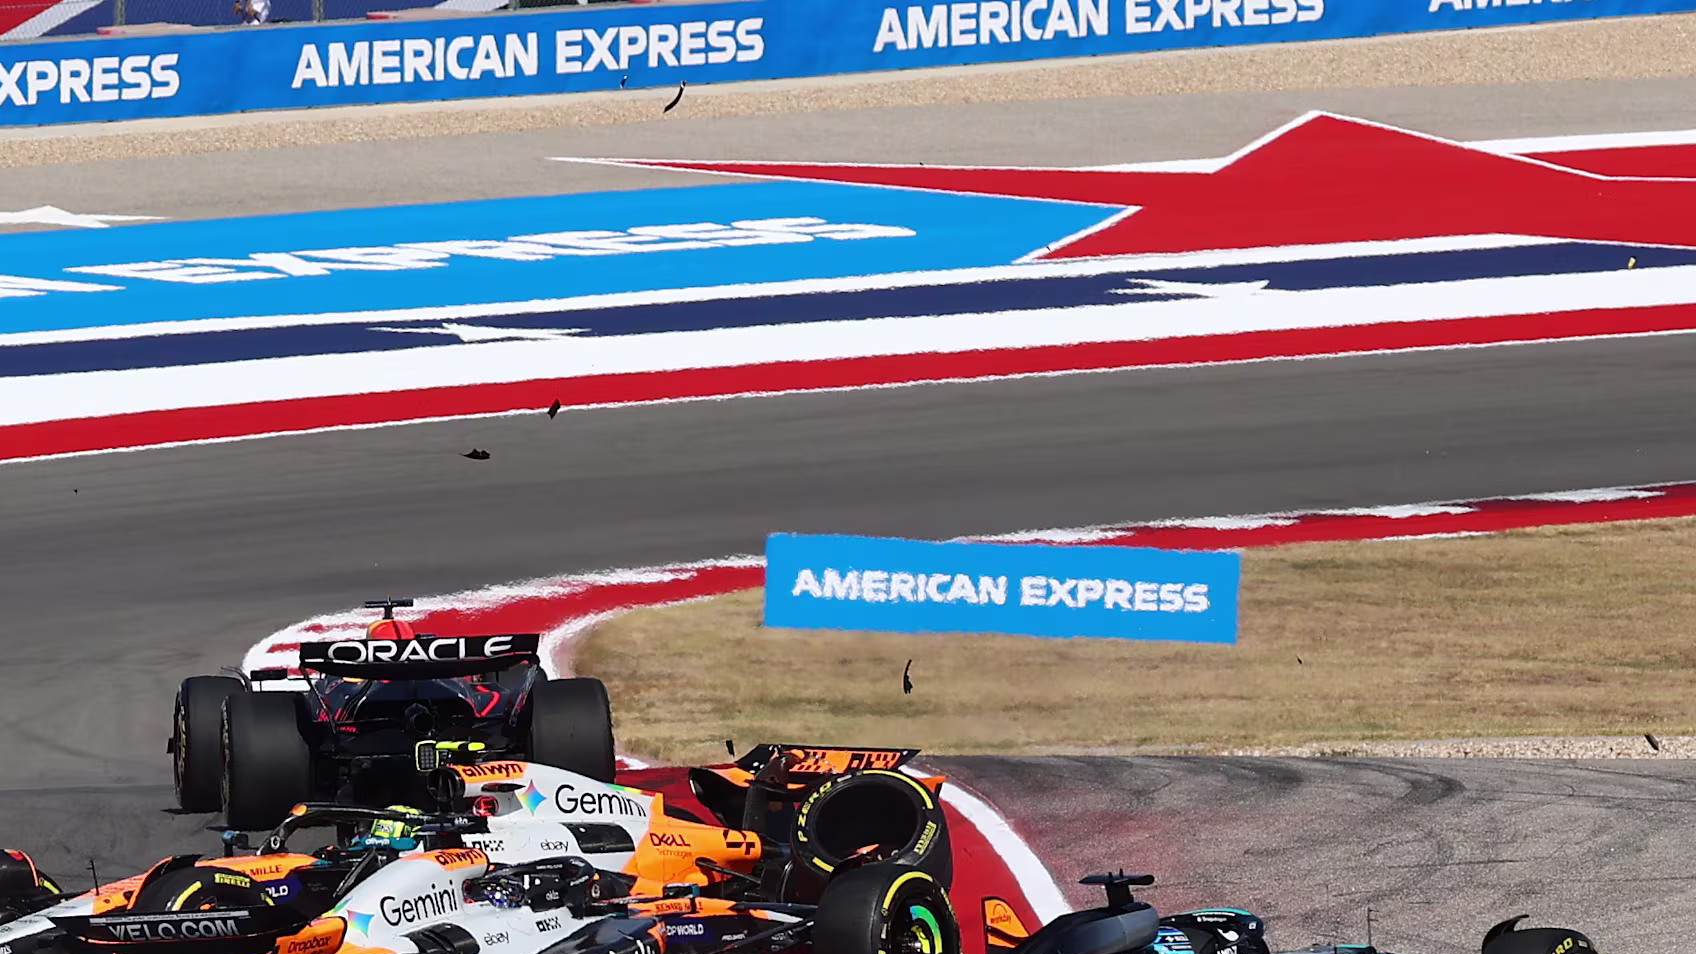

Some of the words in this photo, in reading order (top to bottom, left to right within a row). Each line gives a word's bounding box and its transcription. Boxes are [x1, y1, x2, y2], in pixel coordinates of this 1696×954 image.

[874, 0, 1105, 52] AMERICAN
[293, 32, 539, 89] AMERICAN
[555, 18, 765, 75] EXPRESS
[64, 216, 917, 286] EXPRESS
[792, 567, 1008, 606] AMERICAN
[1019, 574, 1210, 613] EXPRESS
[327, 635, 514, 664] ORACLE
[462, 761, 524, 781] allwyn
[555, 784, 647, 818] Gemini
[798, 781, 832, 825] ZERO
[540, 838, 570, 852] ebay
[649, 833, 692, 848] DELL
[434, 848, 484, 866] allwyn
[380, 879, 459, 928] Gemini
[108, 919, 240, 941] VELO.COM
[483, 931, 510, 946] ebay
[677, 923, 704, 935] WORLD
[287, 935, 333, 954] Dropbox
